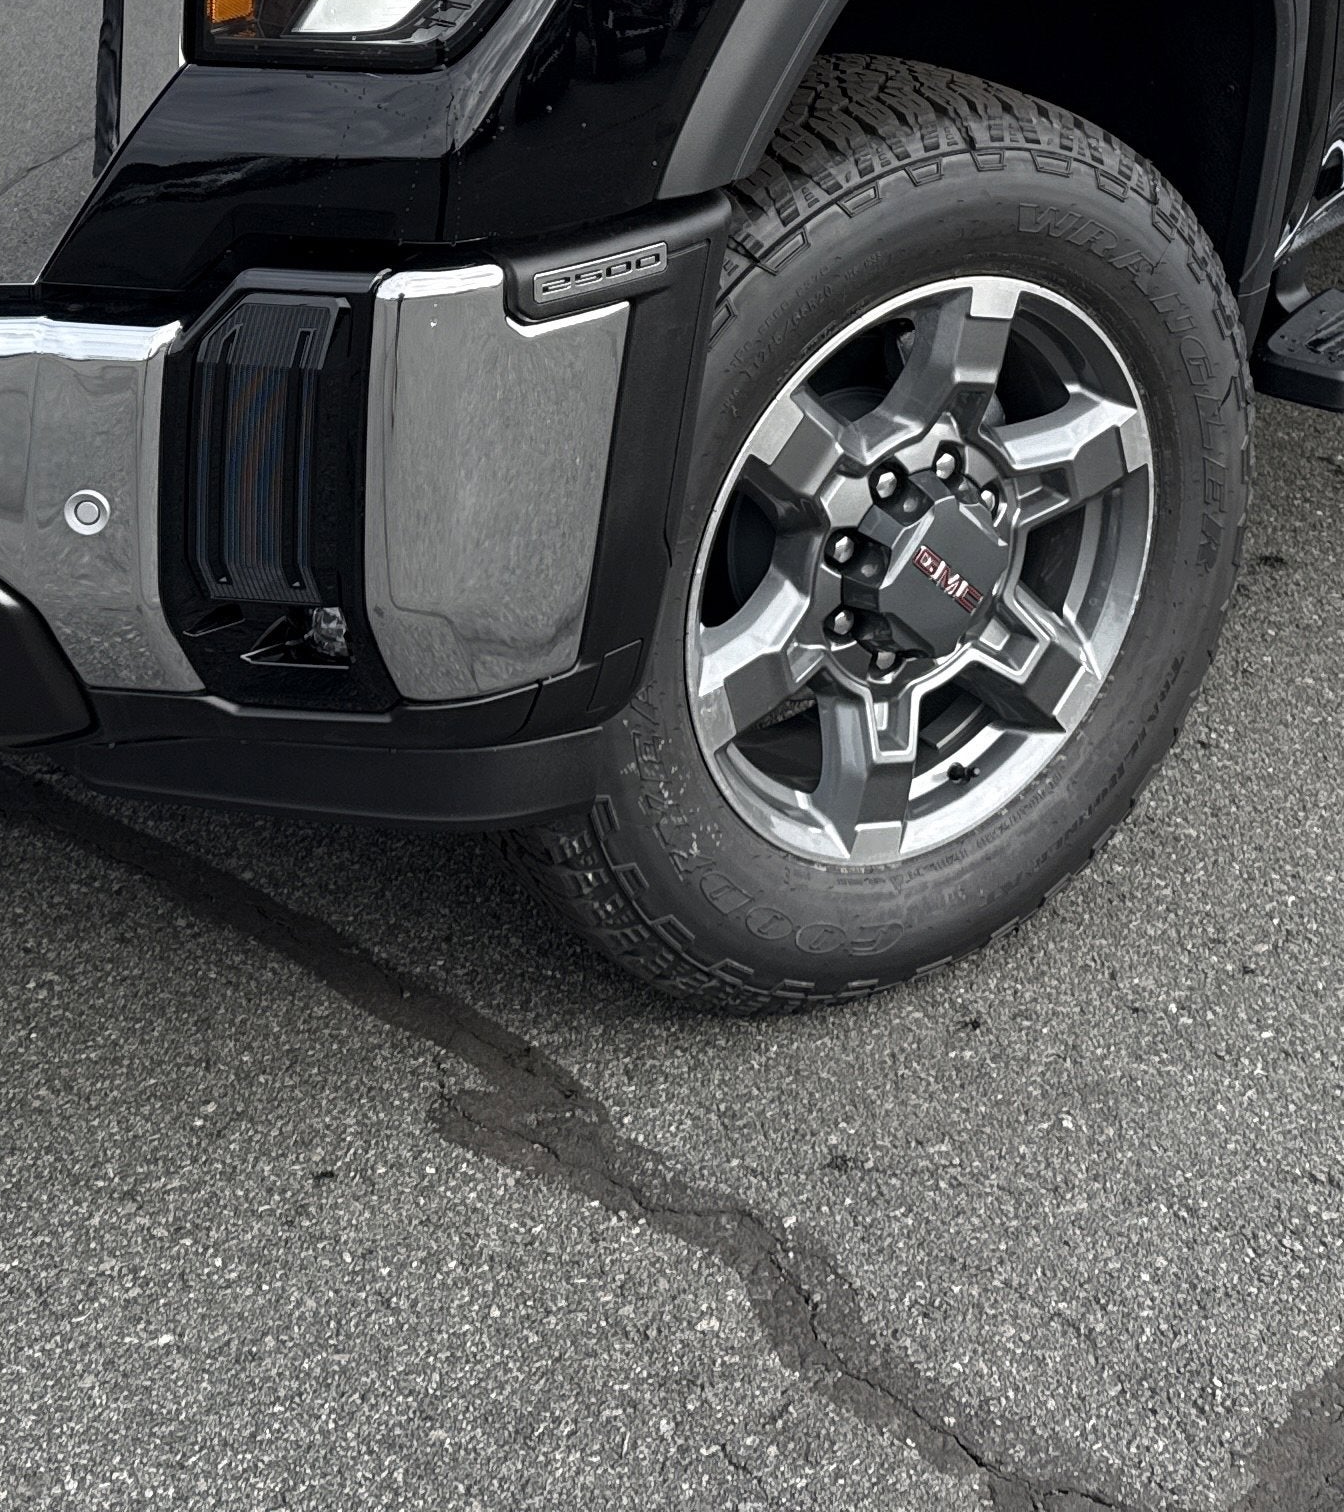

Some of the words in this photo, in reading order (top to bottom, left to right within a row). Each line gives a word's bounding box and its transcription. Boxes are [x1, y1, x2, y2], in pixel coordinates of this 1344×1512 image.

[541, 252, 662, 296] 2500
[1015, 200, 1228, 576] WRANGLER
[912, 545, 984, 616] GMC
[631, 680, 905, 956] GOODYEA
